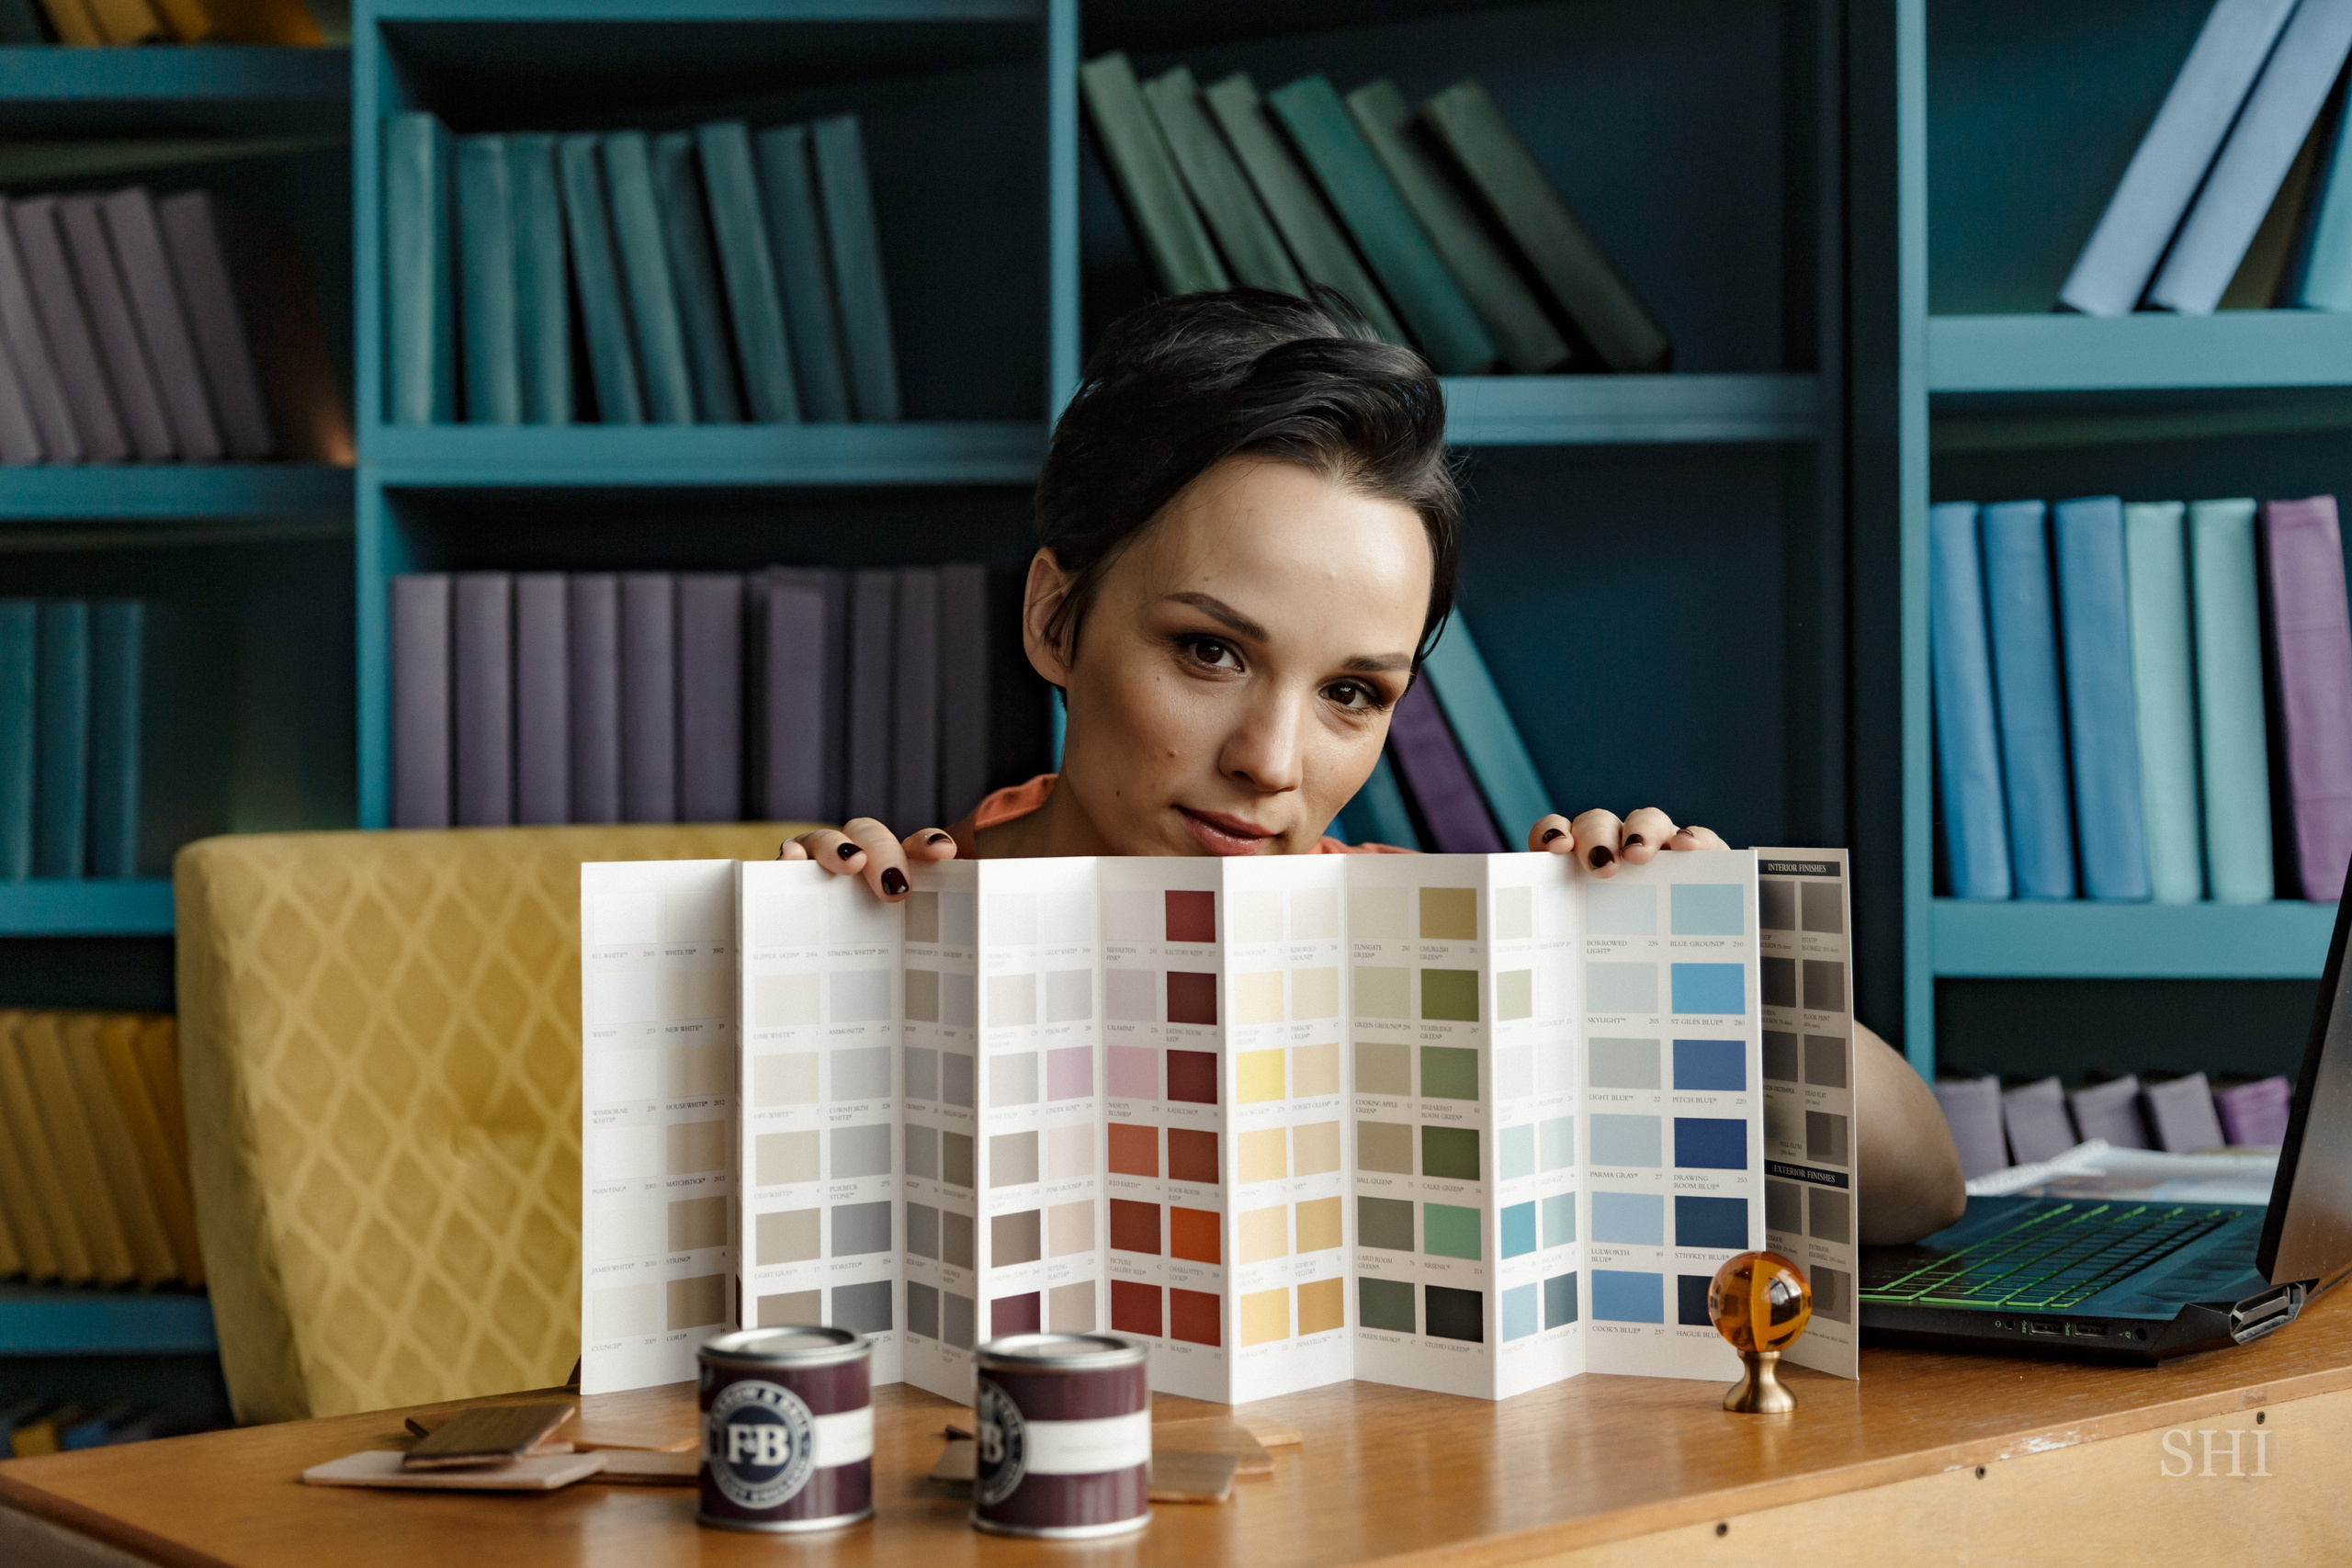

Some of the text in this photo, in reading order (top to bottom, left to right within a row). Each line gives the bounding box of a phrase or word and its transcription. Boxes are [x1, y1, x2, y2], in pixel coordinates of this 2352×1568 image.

[1769, 863, 1826, 873] INTERIOR FINISHES
[1420, 1025, 1453, 1033] YEABRIDGE
[1356, 1100, 1382, 1108] COOKING
[1421, 1104, 1453, 1112] BREAKFAST
[593, 1108, 628, 1116] WIMBORNE
[830, 1105, 869, 1113] CORNFORTH
[1774, 1165, 1836, 1183] EXTERIOR FINISHES
[830, 1184, 858, 1192] PURBECK
[1591, 1248, 1630, 1257] LULWORTH
[1809, 1244, 1829, 1253] EXTERIOR
[1110, 1258, 1132, 1266] PICTURE
[1358, 1255, 1374, 1263] CARD
[592, 1266, 611, 1275] JAMES
[1110, 1266, 1134, 1274] GALLERY
[1359, 1332, 1378, 1341] GREEN
[1425, 1341, 1447, 1350] STUDIO
